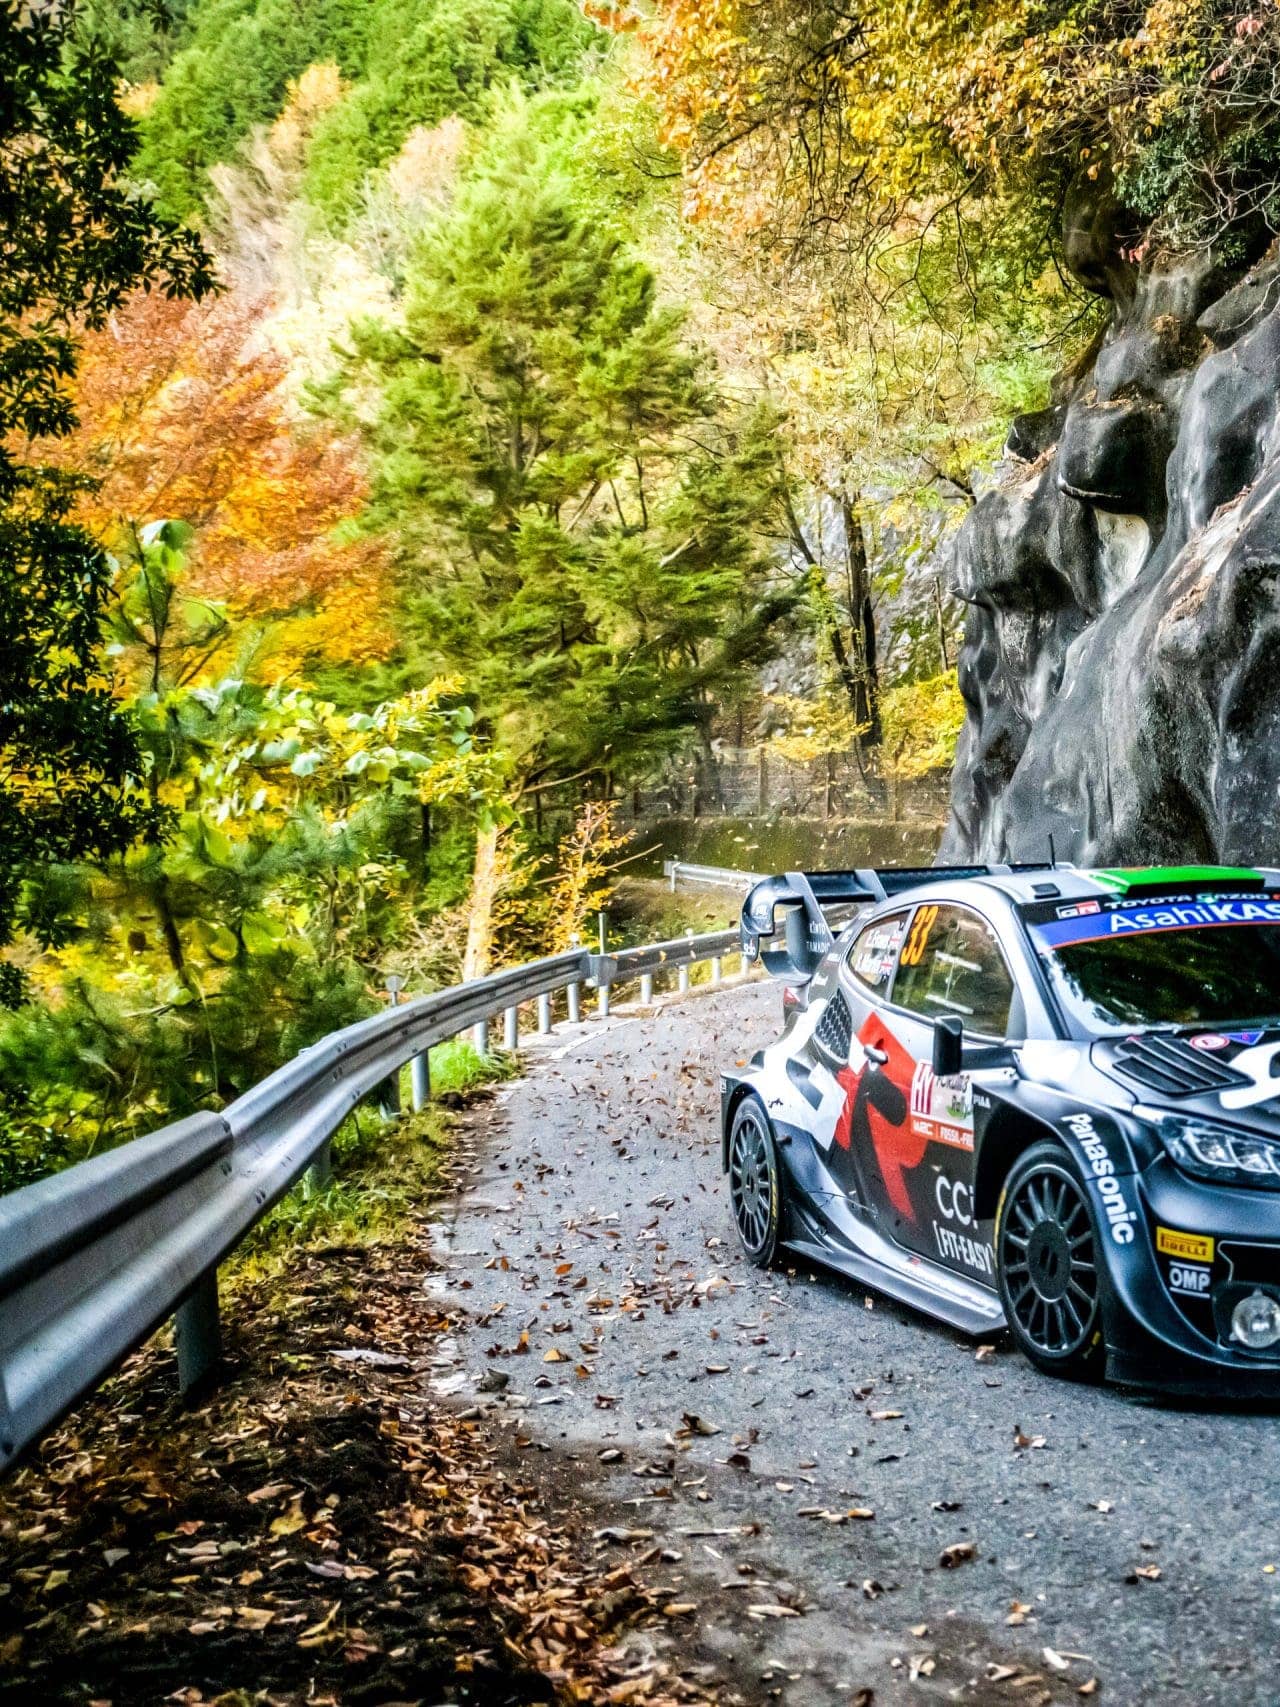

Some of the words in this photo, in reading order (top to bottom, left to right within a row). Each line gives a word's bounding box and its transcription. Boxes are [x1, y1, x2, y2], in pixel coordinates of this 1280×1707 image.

[1105, 895, 1192, 909] TOYOTA
[900, 905, 939, 966] 33
[1061, 1113, 1137, 1245] Panasonic
[1160, 1232, 1209, 1257] PIRELLI
[1169, 1267, 1210, 1291] OMP
